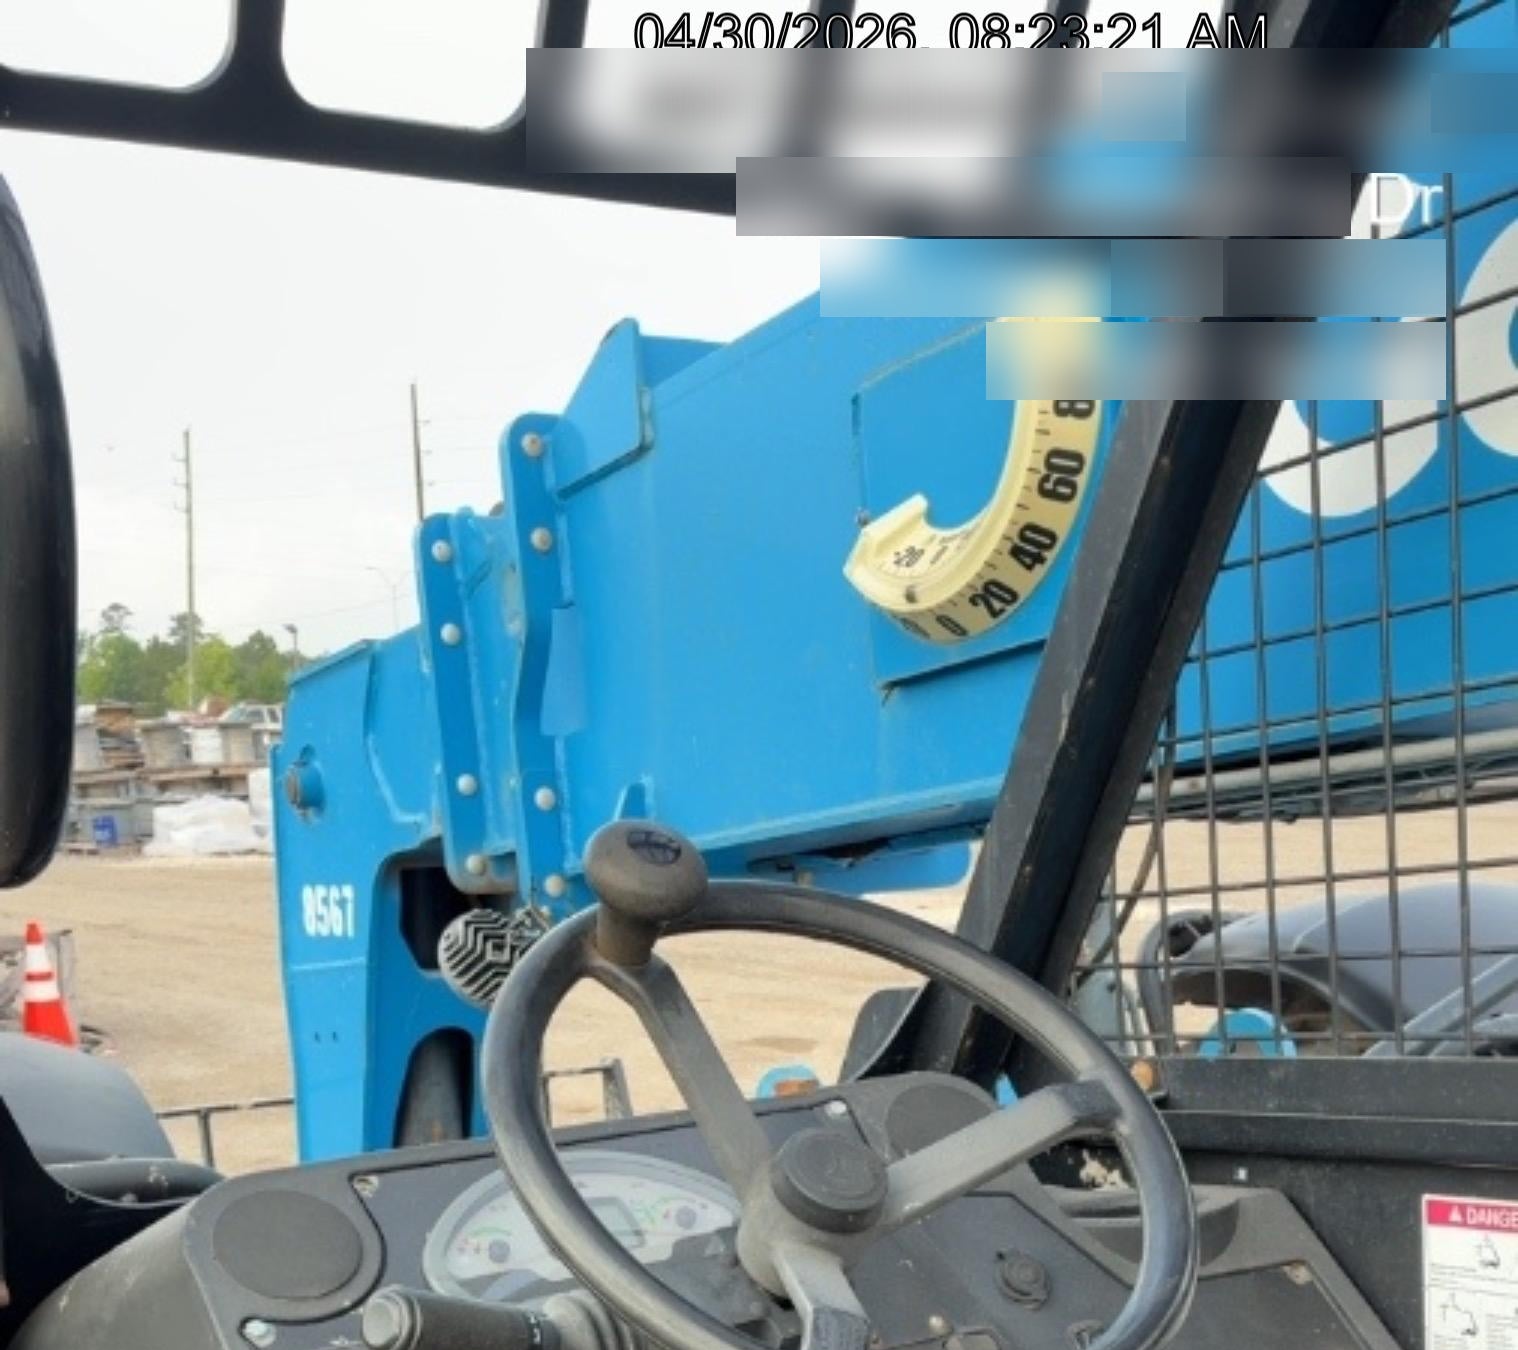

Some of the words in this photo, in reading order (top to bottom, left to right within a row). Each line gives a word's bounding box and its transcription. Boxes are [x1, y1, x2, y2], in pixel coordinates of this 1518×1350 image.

[1038, 448, 1085, 503] 60
[1010, 522, 1059, 571] 40
[968, 579, 1019, 619] 20
